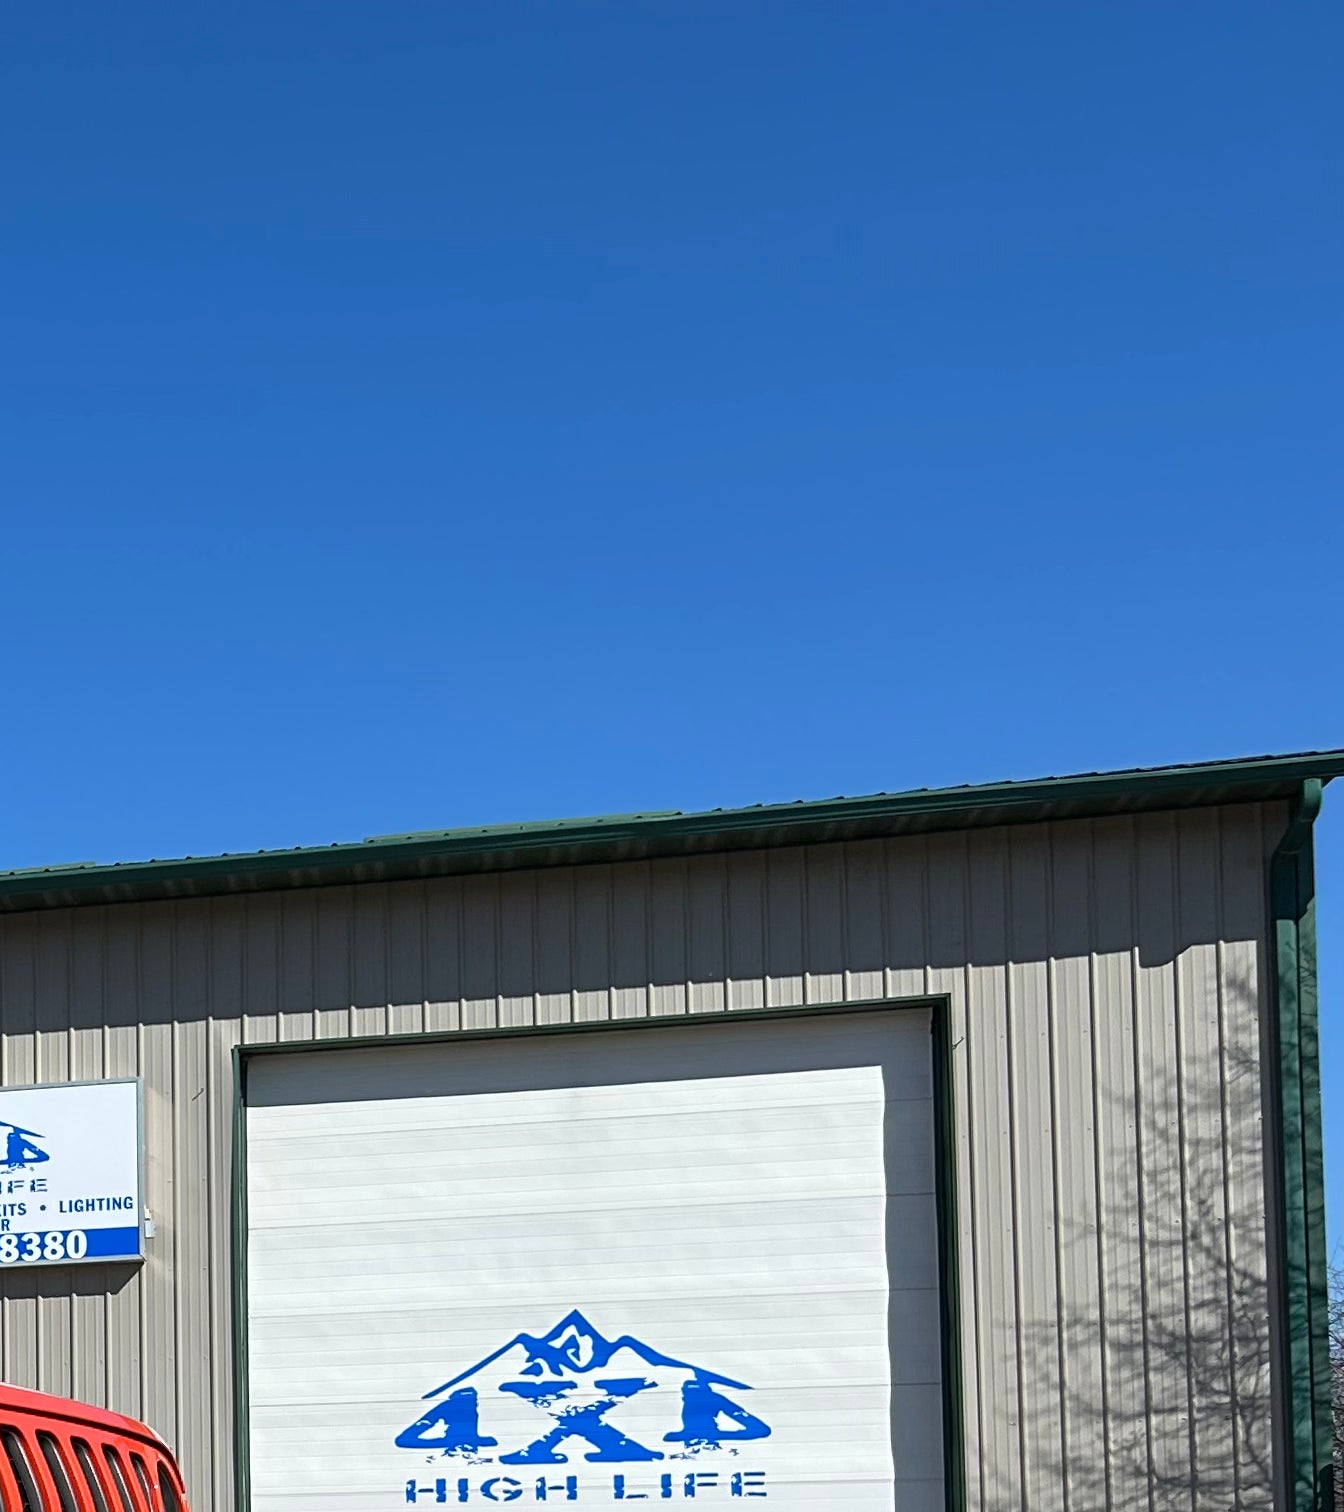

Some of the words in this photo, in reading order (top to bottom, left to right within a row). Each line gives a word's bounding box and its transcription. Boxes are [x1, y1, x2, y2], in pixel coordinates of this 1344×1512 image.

[58, 1196, 134, 1214] LIGHTING
[405, 1475, 578, 1504] HIGH
[613, 1471, 767, 1500] LIFE
